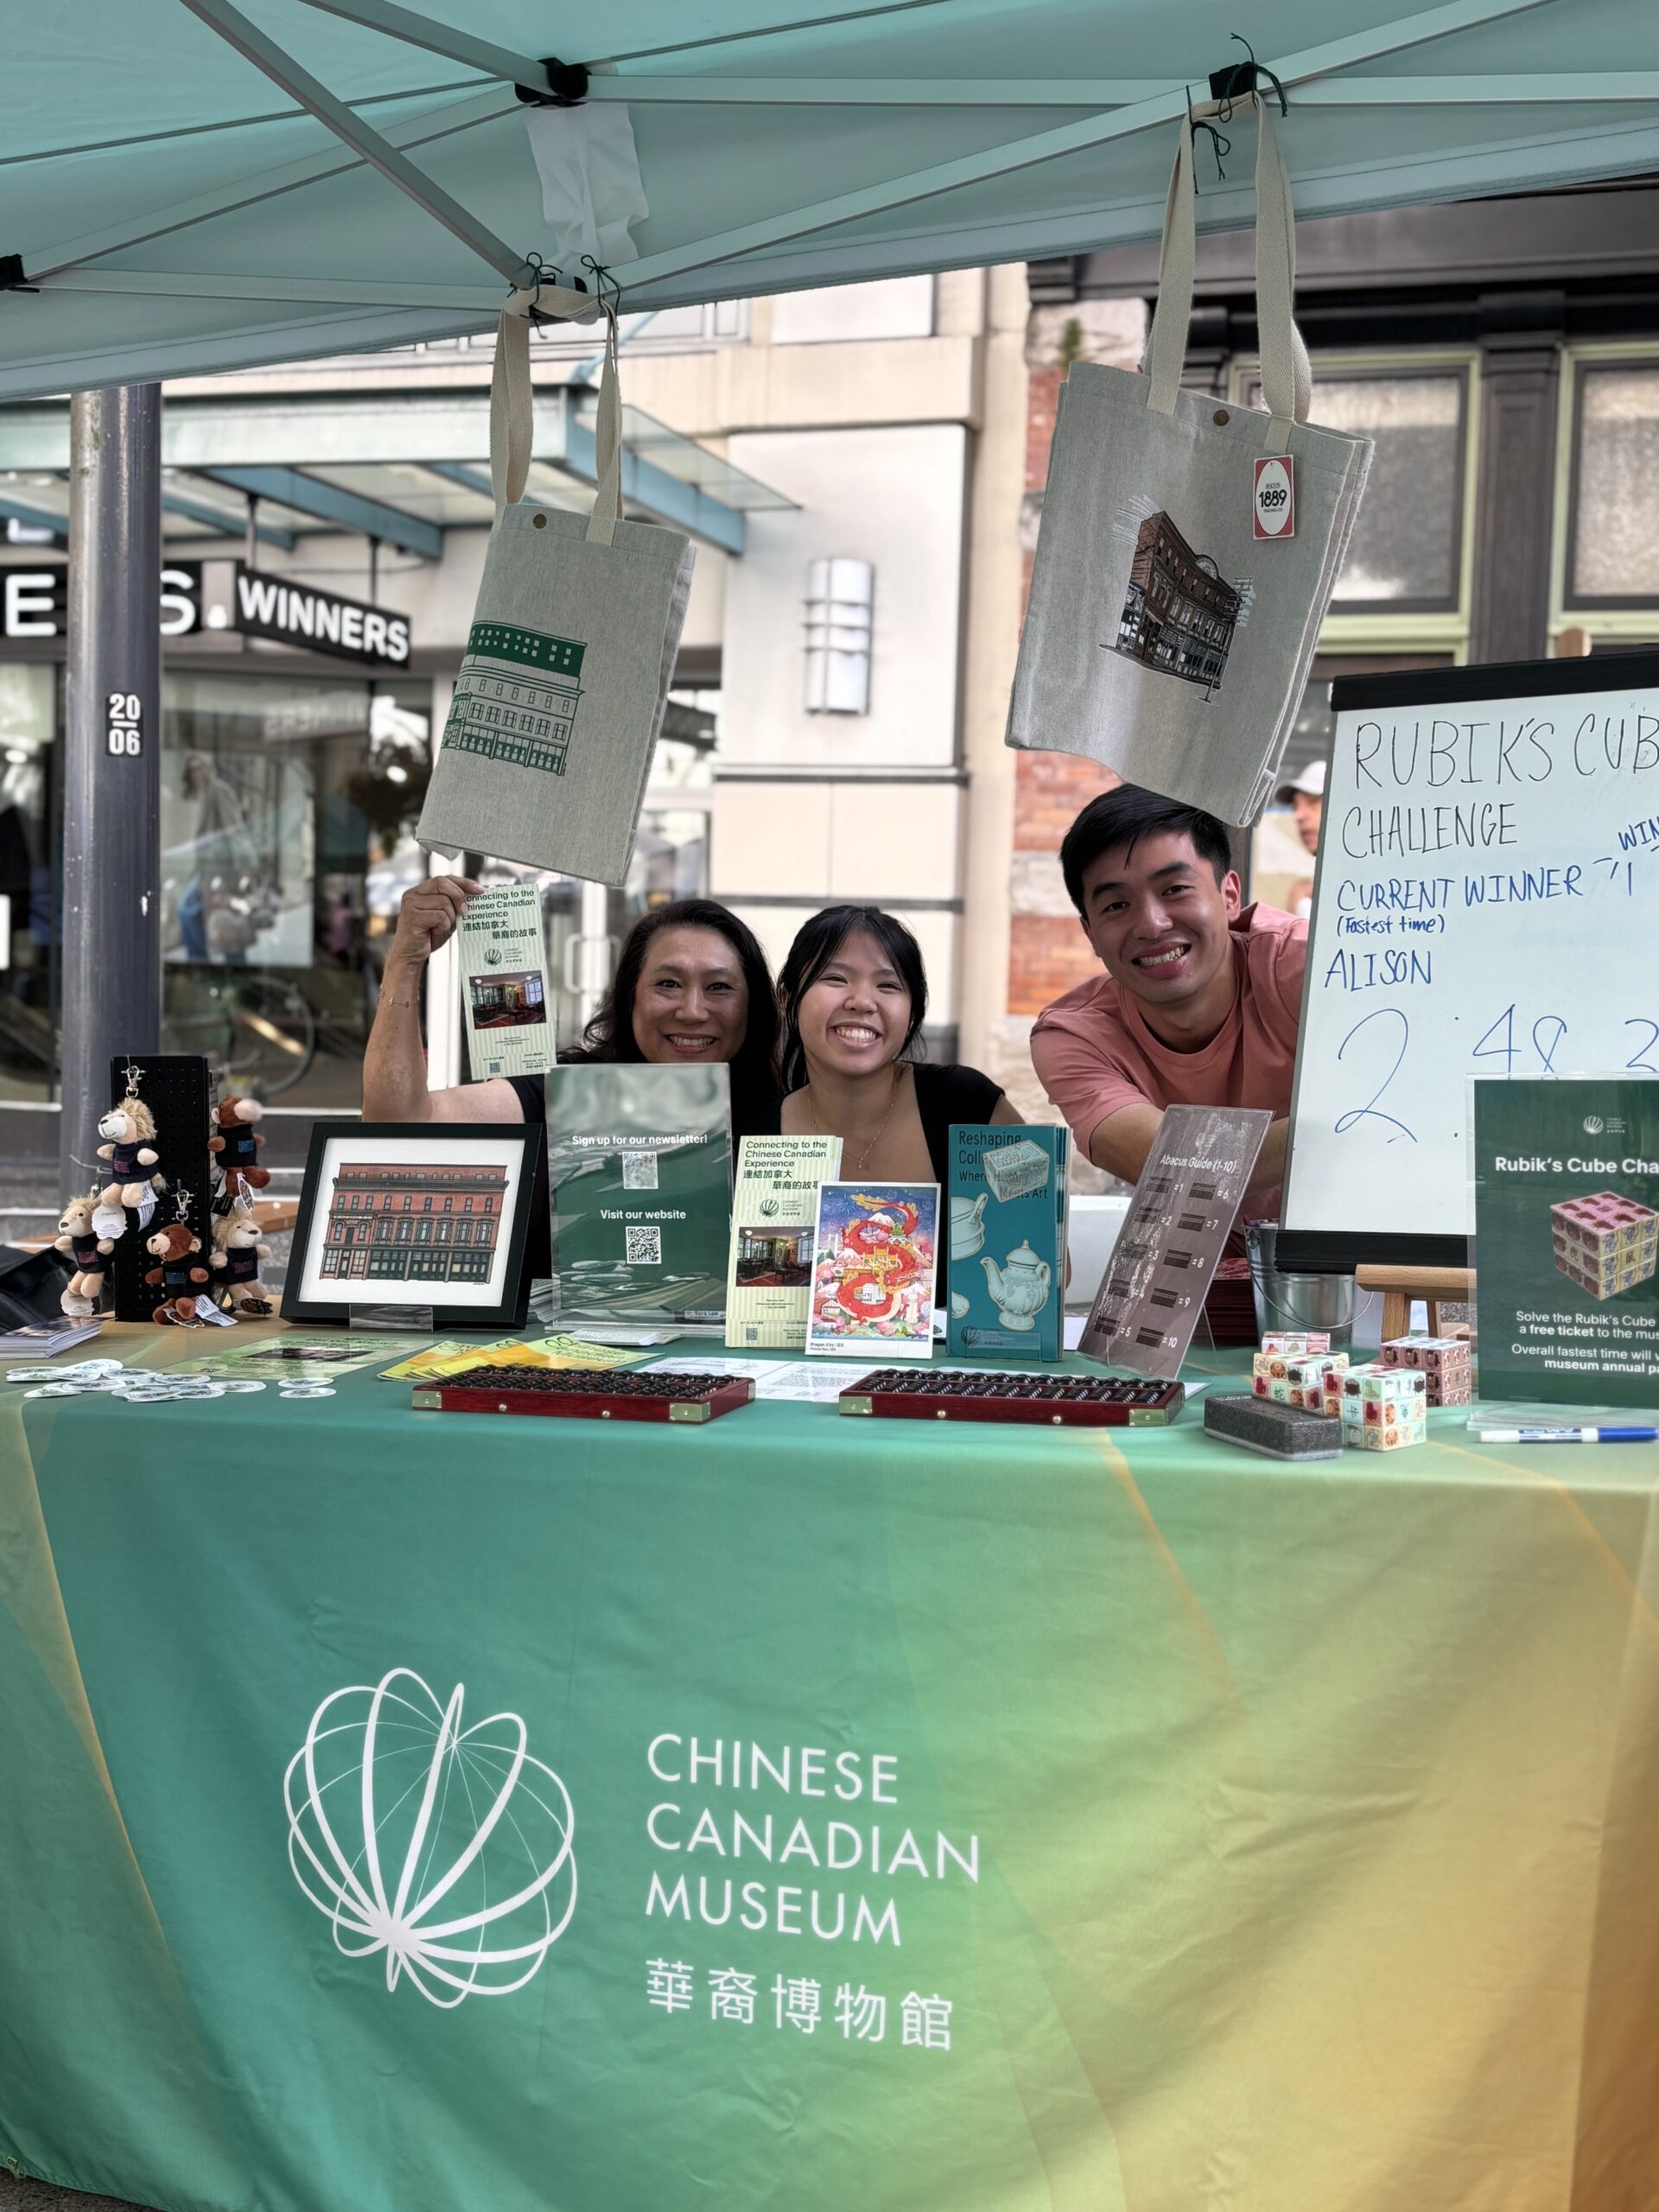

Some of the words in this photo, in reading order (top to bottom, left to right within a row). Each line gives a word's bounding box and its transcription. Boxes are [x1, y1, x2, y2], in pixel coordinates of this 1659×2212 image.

[1259, 489, 1287, 507] 1889
[238, 575, 409, 661] WINNERS
[109, 694, 140, 720] 20
[109, 728, 140, 756] 06
[1355, 718, 1554, 789] RUBIK'S
[1342, 803, 1518, 859] CHALLENGE
[467, 892, 509, 902] onnecting
[1337, 878, 1455, 912] CURRENT
[1465, 865, 1584, 906] WINNER
[467, 903, 495, 912] hinese
[497, 899, 536, 908] Canadian
[462, 911, 509, 922] Experience
[1401, 914, 1446, 934] time)
[1325, 949, 1432, 991] ALISON
[572, 1135, 594, 1147] Sign
[597, 1138, 610, 1147] up
[613, 1135, 626, 1144] for
[649, 1135, 708, 1144] newsletter!
[958, 1131, 1021, 1147] Reshaping
[744, 1160, 795, 1168] Experience
[1160, 1154, 1187, 1166] Abacus
[1188, 1157, 1212, 1169] Guide
[1212, 1159, 1236, 1173] (1-10)
[1567, 1158, 1618, 1173] Cube
[1622, 1159, 1659, 1173] Cha
[1032, 1189, 1047, 1198] Art
[601, 1210, 623, 1219] Visit
[645, 1210, 687, 1219] website
[1516, 1311, 1549, 1322] Solve
[1553, 1313, 1572, 1323] the
[1622, 1316, 1656, 1327] Cube
[1529, 1325, 1555, 1335] free
[1557, 1325, 1594, 1338] ticket
[1598, 1328, 1609, 1338] to
[1612, 1328, 1632, 1338] the
[1511, 1344, 1554, 1356] Overall
[1557, 1345, 1598, 1358] fastest
[1600, 1349, 1628, 1359] time
[1631, 1350, 1651, 1360] will
[1544, 1360, 1599, 1371] museum
[1602, 1362, 1645, 1373] annual
[647, 1733, 899, 1803] CHINESE
[646, 1802, 979, 1884] CANADIAN
[645, 1871, 901, 1947] MUSEUM
[646, 1957, 954, 2050] 華裔博物館
